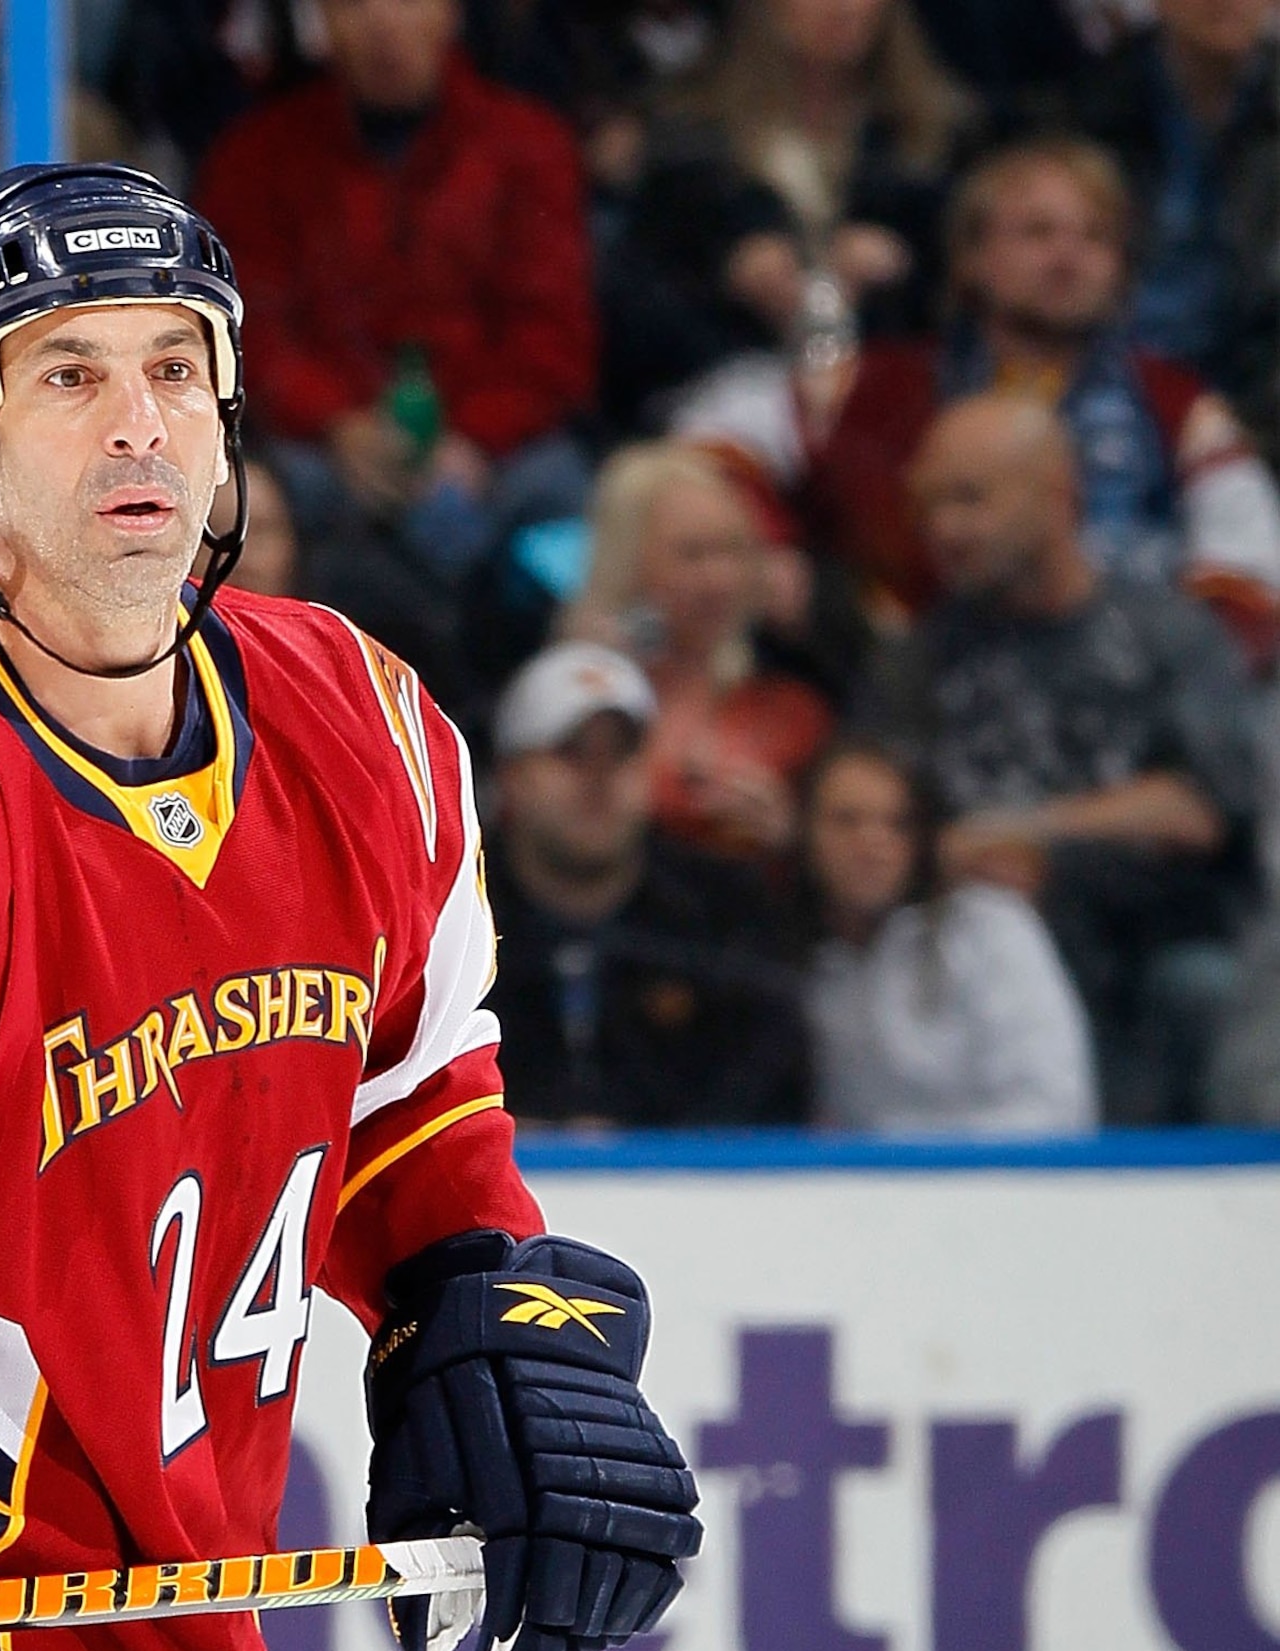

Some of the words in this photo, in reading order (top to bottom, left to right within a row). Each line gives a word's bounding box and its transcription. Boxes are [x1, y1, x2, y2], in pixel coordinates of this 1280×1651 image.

[73, 231, 155, 248] CCM
[37, 934, 387, 1178] THRASHER
[149, 1140, 331, 1471] 24
